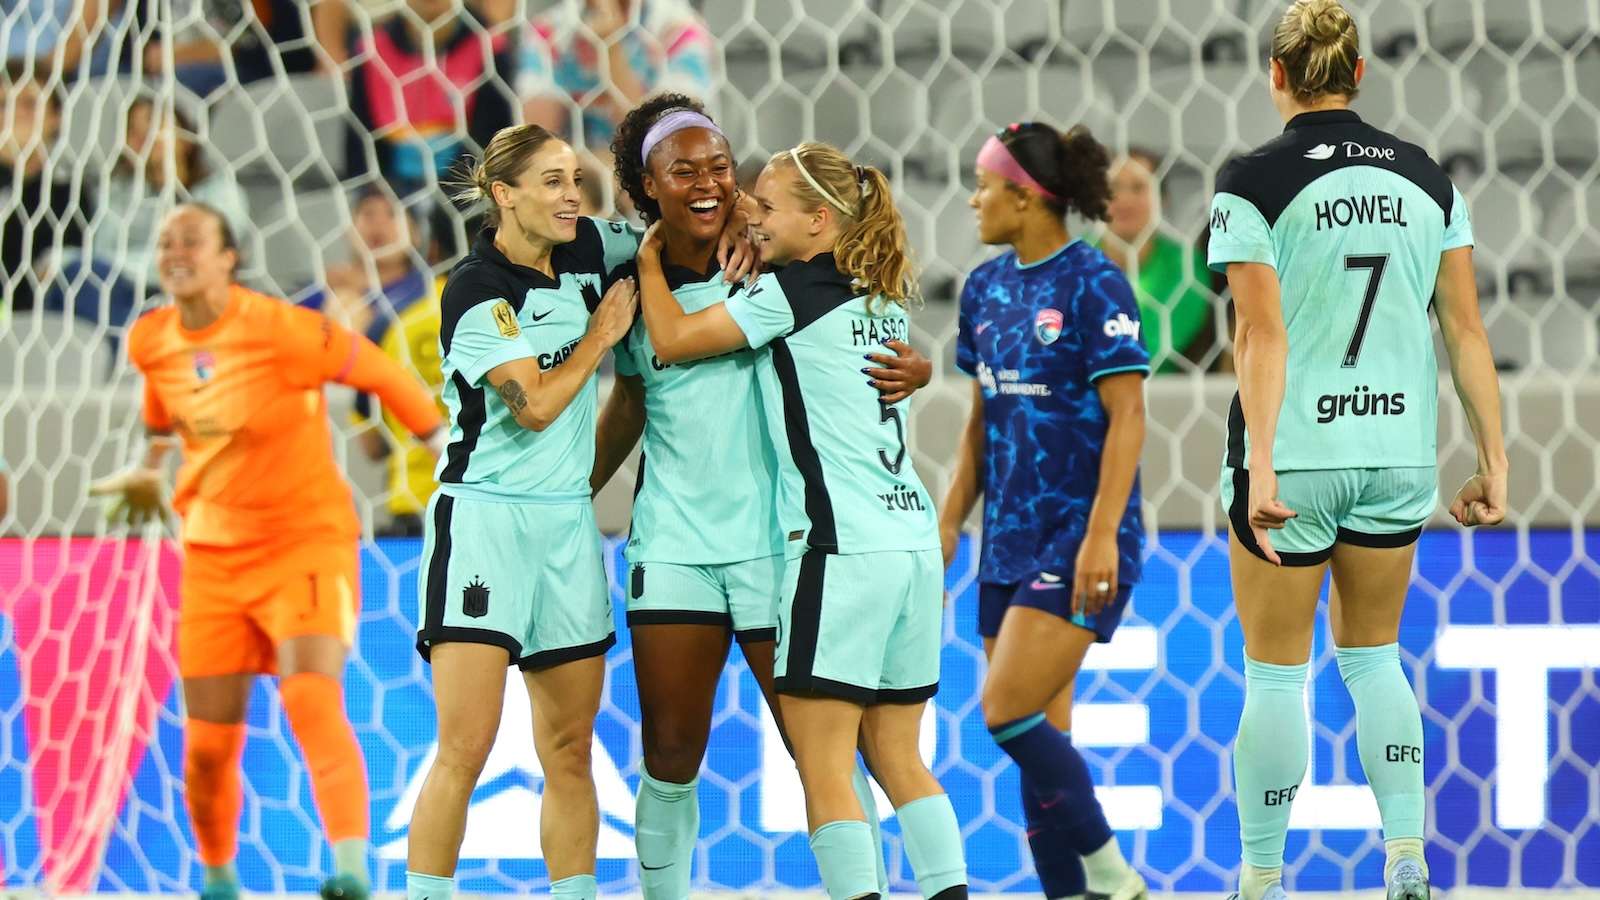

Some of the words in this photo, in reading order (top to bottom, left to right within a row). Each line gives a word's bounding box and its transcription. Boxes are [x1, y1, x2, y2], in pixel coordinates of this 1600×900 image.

[1342, 141, 1396, 161] Dove
[1315, 195, 1407, 231] HOWELL
[1341, 253, 1391, 368] 7
[1317, 385, 1405, 424] grüns
[1386, 744, 1421, 764] GFC
[1264, 784, 1299, 807] GFC
